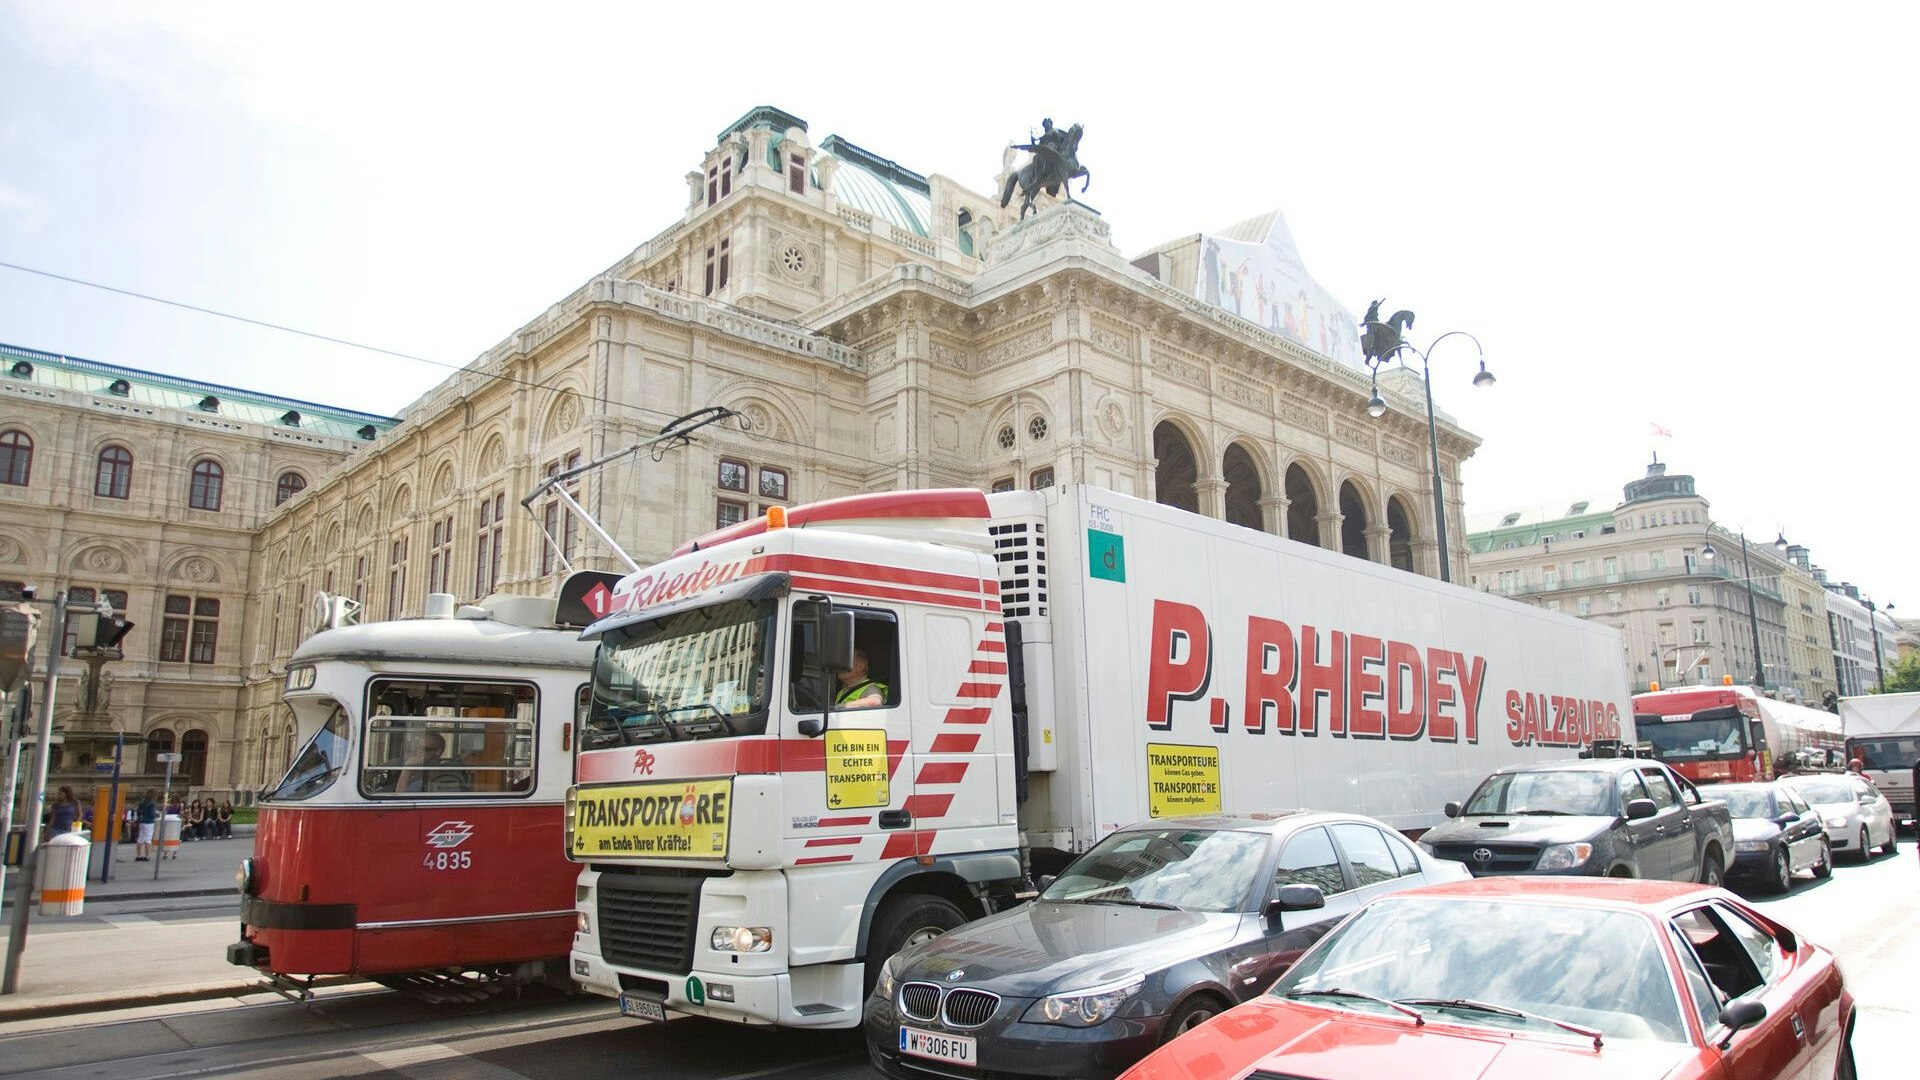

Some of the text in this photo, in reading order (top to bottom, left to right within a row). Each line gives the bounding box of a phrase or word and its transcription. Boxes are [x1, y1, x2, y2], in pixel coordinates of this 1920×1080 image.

[1090, 505, 1110, 521] FRC
[1103, 544, 1116, 570] d
[594, 589, 604, 613] 1
[1146, 598, 1487, 745] P. RHEDEY
[1506, 689, 1621, 748] SALZBURG
[833, 743, 880, 752] ICH BIN EIN
[842, 758, 874, 768] ECHTER
[1149, 754, 1218, 768] TRANSPORTEURE
[828, 771, 887, 784] TRANSPORTÖR
[1164, 768, 1181, 776] können
[1153, 780, 1217, 794] TRANSPORTÖRE
[578, 785, 726, 828] TRANSPORTÖRE
[1166, 795, 1183, 803] können
[598, 834, 692, 851] am Ende ihrer Kräfte!
[422, 850, 472, 870] 4835
[690, 980, 701, 1004] L
[910, 1033, 967, 1060] W 306 FU
